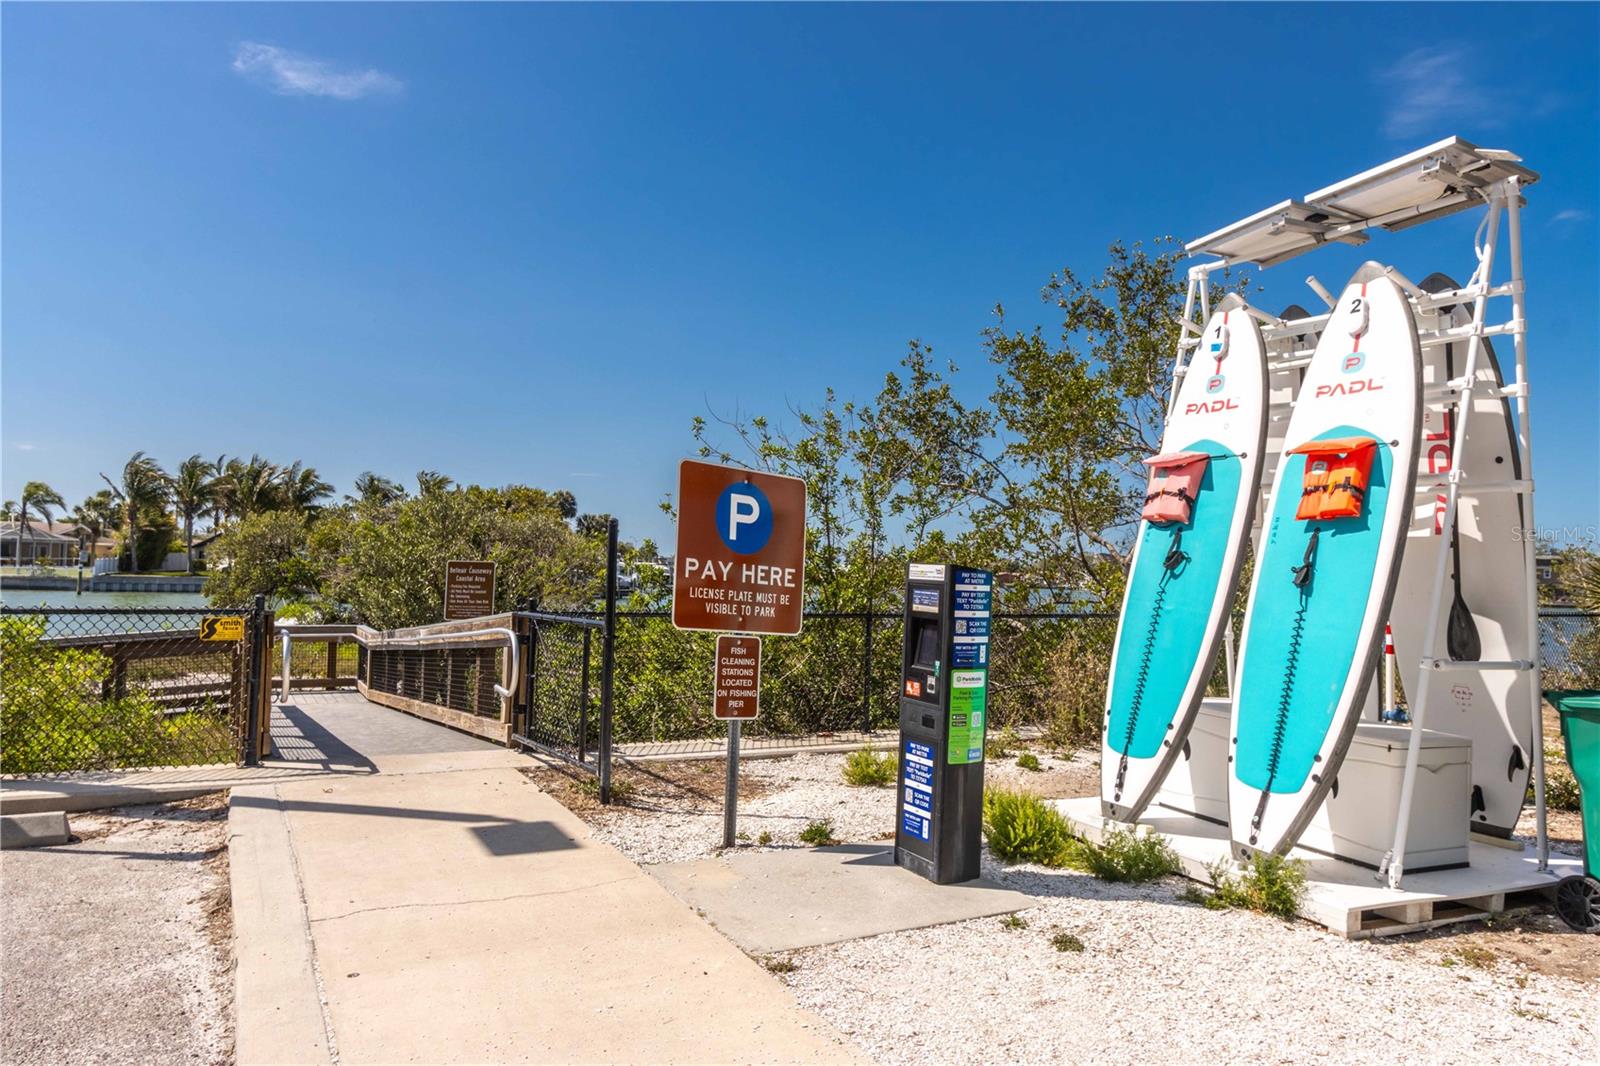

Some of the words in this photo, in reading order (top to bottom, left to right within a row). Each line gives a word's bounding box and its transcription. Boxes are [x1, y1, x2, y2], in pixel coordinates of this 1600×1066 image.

[1350, 298, 1361, 314] 2
[1214, 326, 1222, 339] 1
[1345, 356, 1360, 369] P
[1210, 379, 1222, 390] P
[1316, 378, 1384, 398] PADL
[1185, 398, 1239, 415] PADL
[729, 493, 760, 540] P
[469, 567, 492, 575] Causeway
[685, 558, 733, 581] PAY
[742, 564, 796, 588] HERE
[690, 587, 724, 600] LICENSE
[728, 591, 752, 602] PLATE
[756, 593, 776, 604] MUST
[780, 594, 790, 605] BE
[706, 604, 737, 615] VISIBLE
[741, 605, 752, 616] TO
[755, 606, 776, 617] PARK
[722, 658, 755, 666] CLEANING
